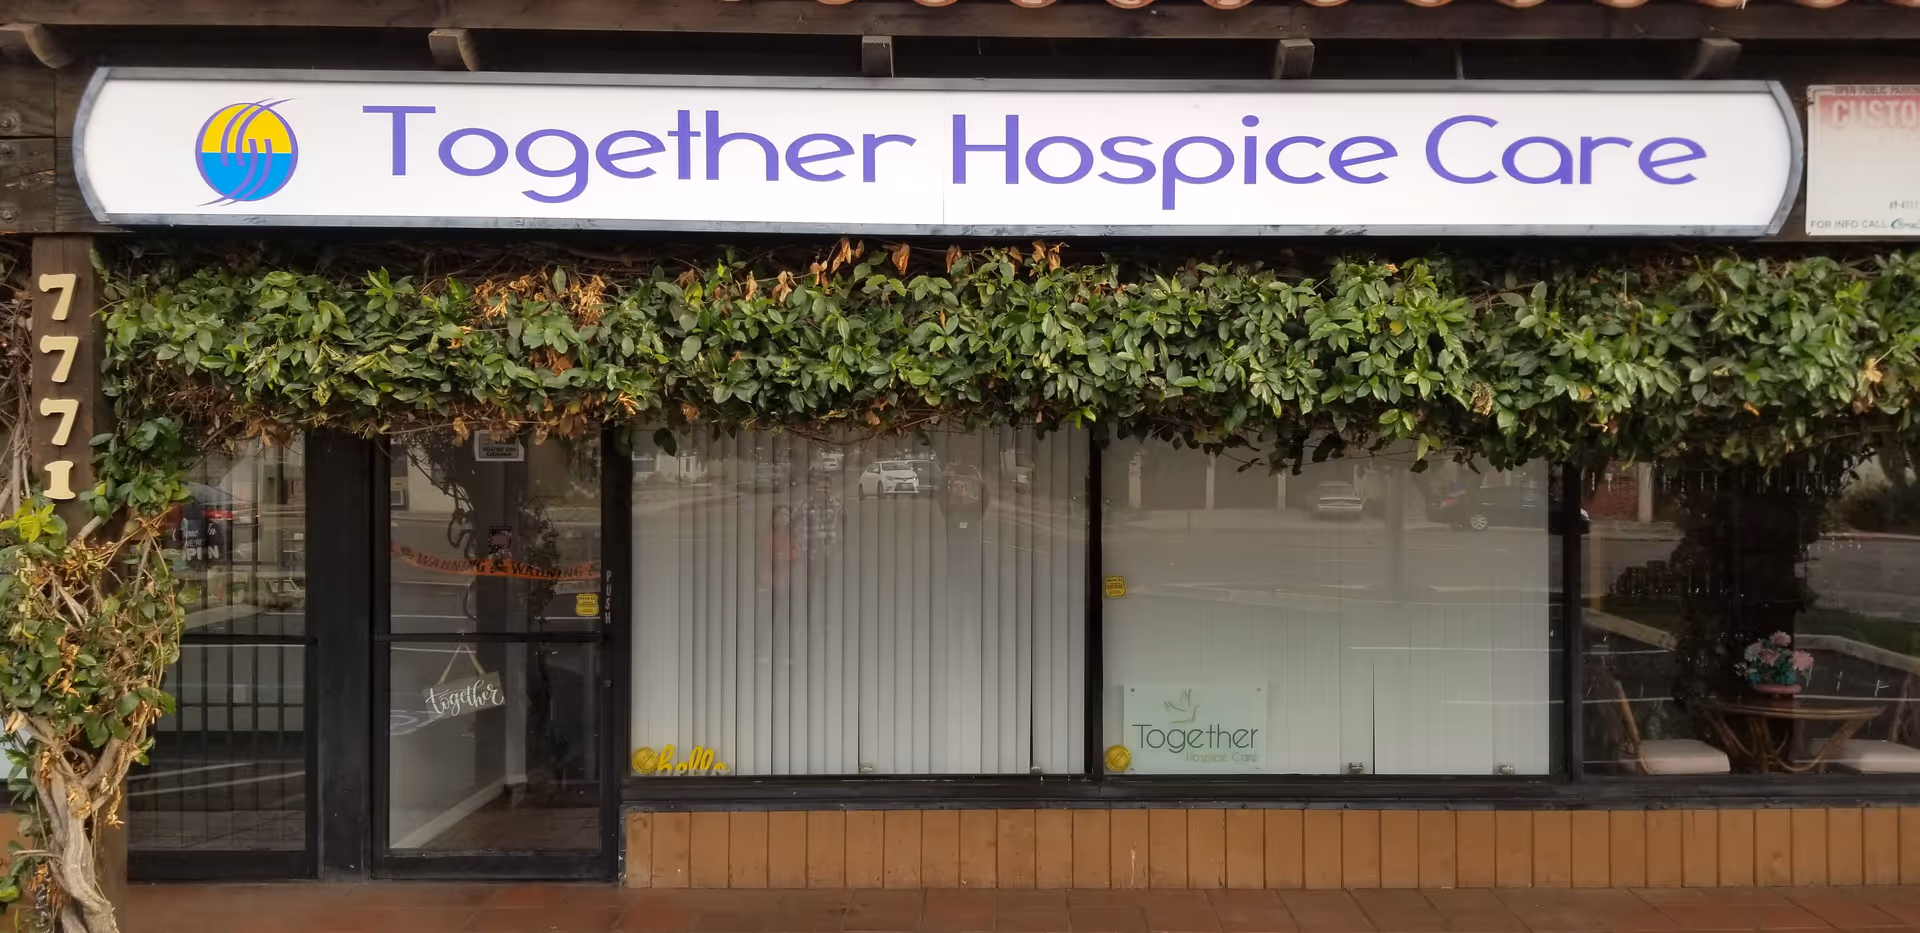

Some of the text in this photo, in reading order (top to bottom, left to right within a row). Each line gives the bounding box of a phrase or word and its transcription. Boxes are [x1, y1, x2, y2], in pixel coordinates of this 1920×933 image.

[362, 106, 1707, 210] Together Hospice Care
[1810, 220, 1832, 229] FOR
[1834, 220, 1858, 229] INFO
[39, 273, 80, 500] 7771
[425, 679, 504, 717] together
[1131, 723, 1259, 754] Together
[1231, 751, 1259, 763] Care
